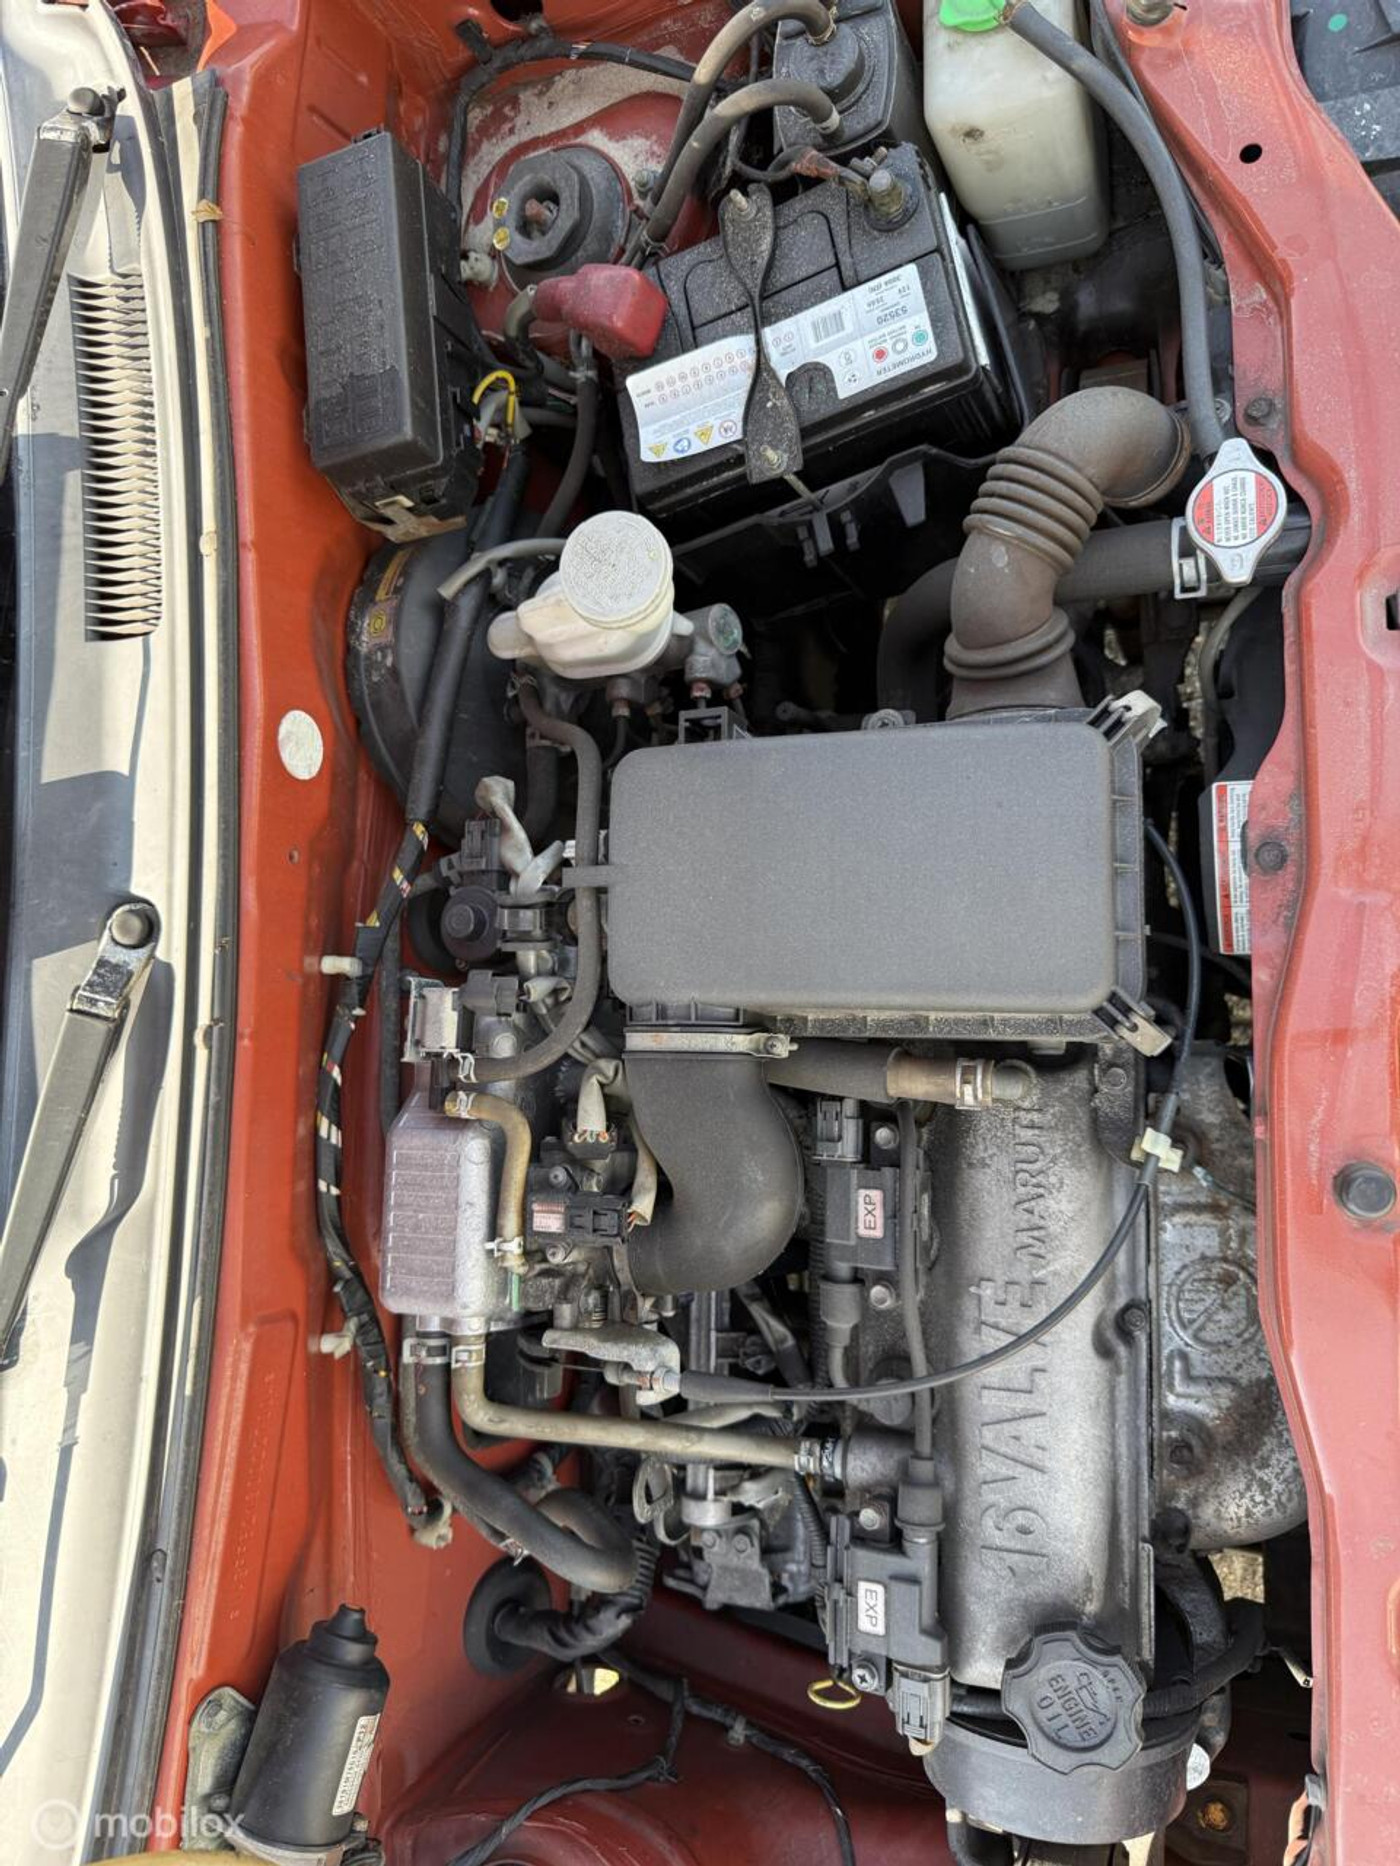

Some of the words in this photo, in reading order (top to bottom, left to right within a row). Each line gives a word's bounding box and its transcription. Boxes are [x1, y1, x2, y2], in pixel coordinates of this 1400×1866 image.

[877, 304, 908, 325] 53520
[876, 346, 932, 376] HYDROMETER
[1013, 1107, 1047, 1261] MARUTI
[863, 1193, 876, 1230] EXP
[865, 1588, 878, 1628] EXP
[1037, 1694, 1070, 1739] OIL
[1048, 1674, 1098, 1741] ENGINE
